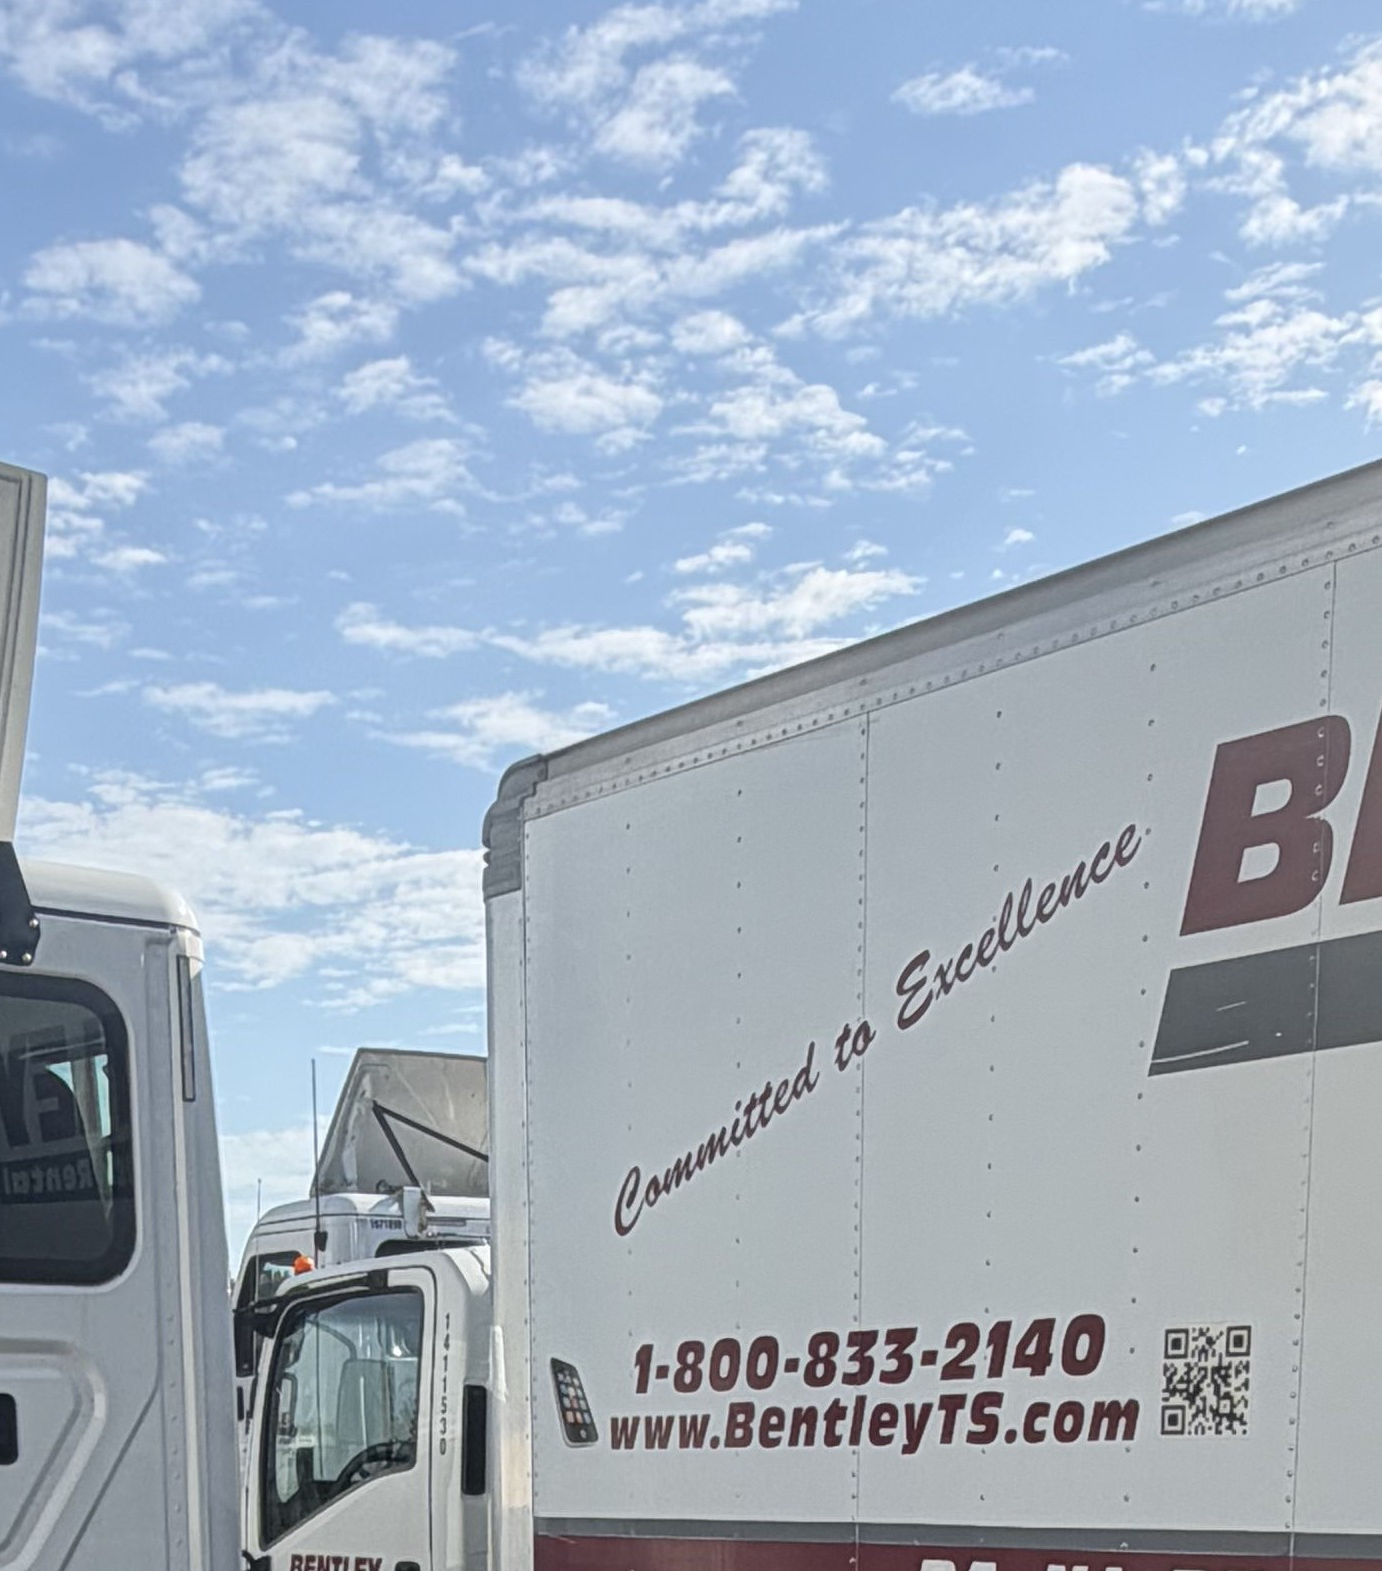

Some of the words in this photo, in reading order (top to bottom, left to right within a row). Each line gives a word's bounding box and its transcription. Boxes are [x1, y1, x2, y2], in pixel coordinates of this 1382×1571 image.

[613, 1041, 819, 1236] Committed
[835, 1014, 875, 1071] to
[895, 824, 1141, 1030] Excellence
[633, 1314, 1106, 1394] 1-800-833-2140
[610, 1391, 1140, 1454] www.BentleyTS.com
